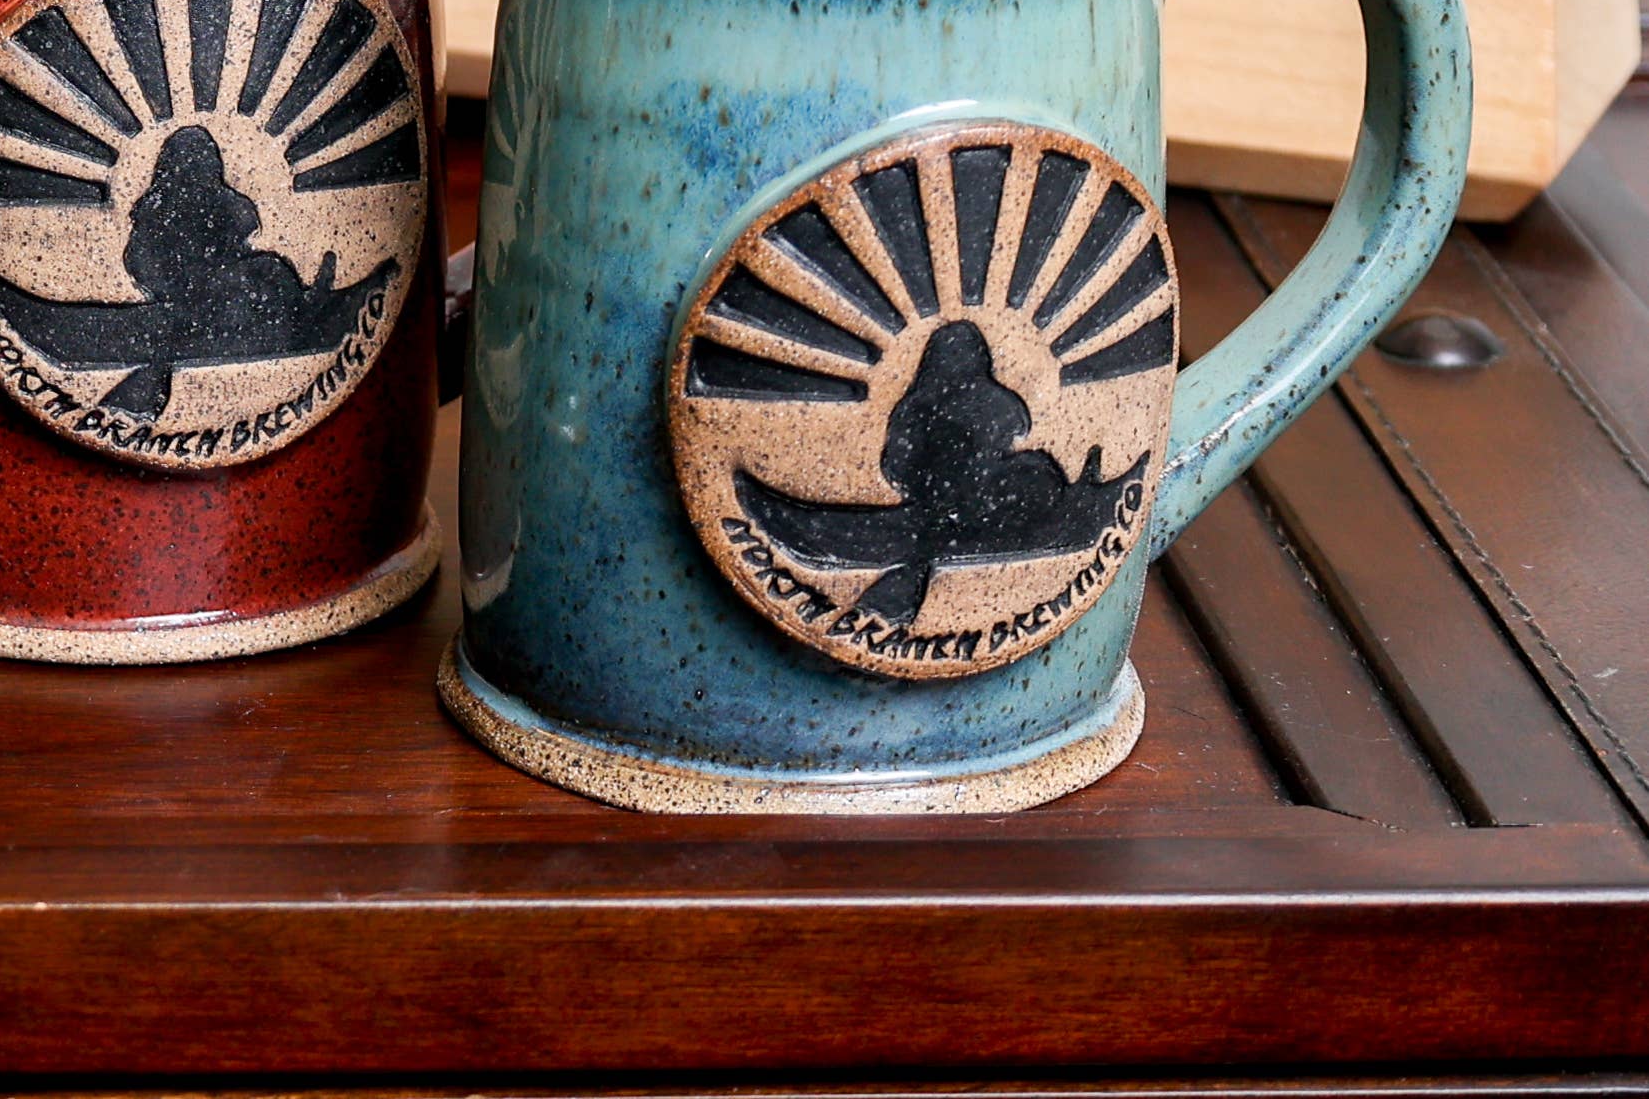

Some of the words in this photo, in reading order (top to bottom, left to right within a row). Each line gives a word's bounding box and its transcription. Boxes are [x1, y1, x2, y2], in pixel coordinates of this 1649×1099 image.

[73, 408, 222, 456] BRANCH
[230, 338, 366, 451] BREWING
[722, 517, 838, 623] NORTH
[829, 609, 982, 661] BRANCH
[989, 531, 1124, 652] BREWING
